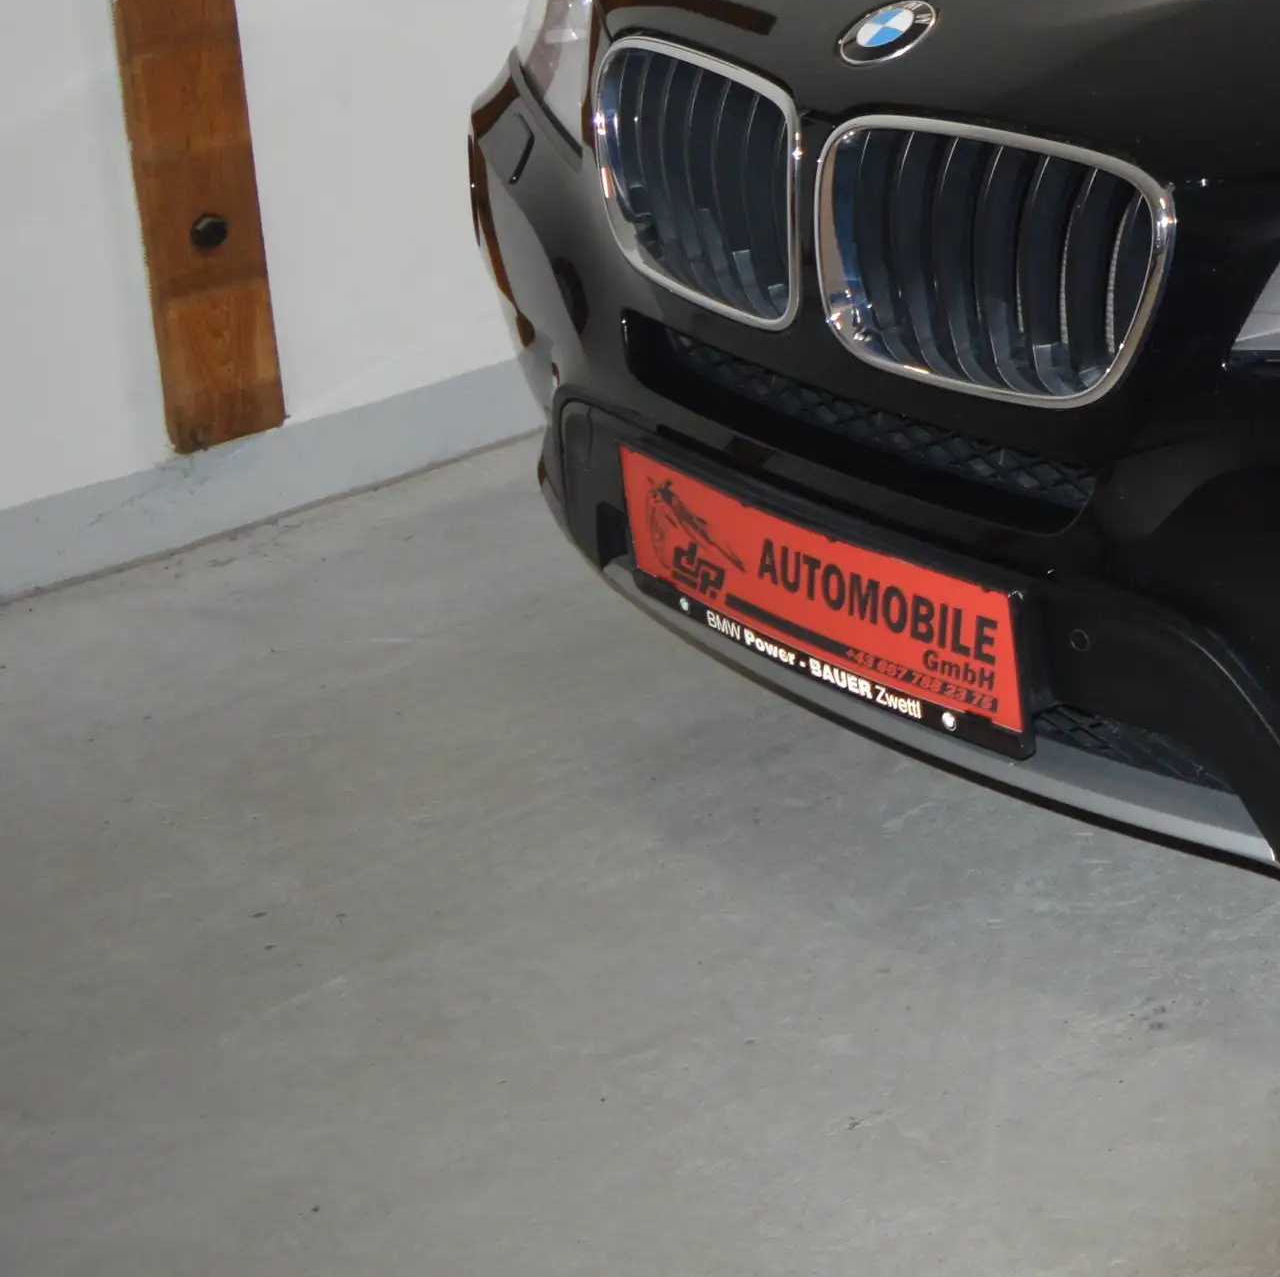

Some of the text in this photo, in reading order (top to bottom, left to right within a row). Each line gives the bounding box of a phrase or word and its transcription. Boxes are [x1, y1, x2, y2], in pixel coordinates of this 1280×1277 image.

[758, 538, 998, 665] AUTOMOBILE
[706, 610, 741, 640] BMW
[743, 629, 796, 665] Power
[808, 657, 872, 700] BAUER
[875, 685, 922, 719] Zwettl
[923, 649, 995, 691] GmbH
